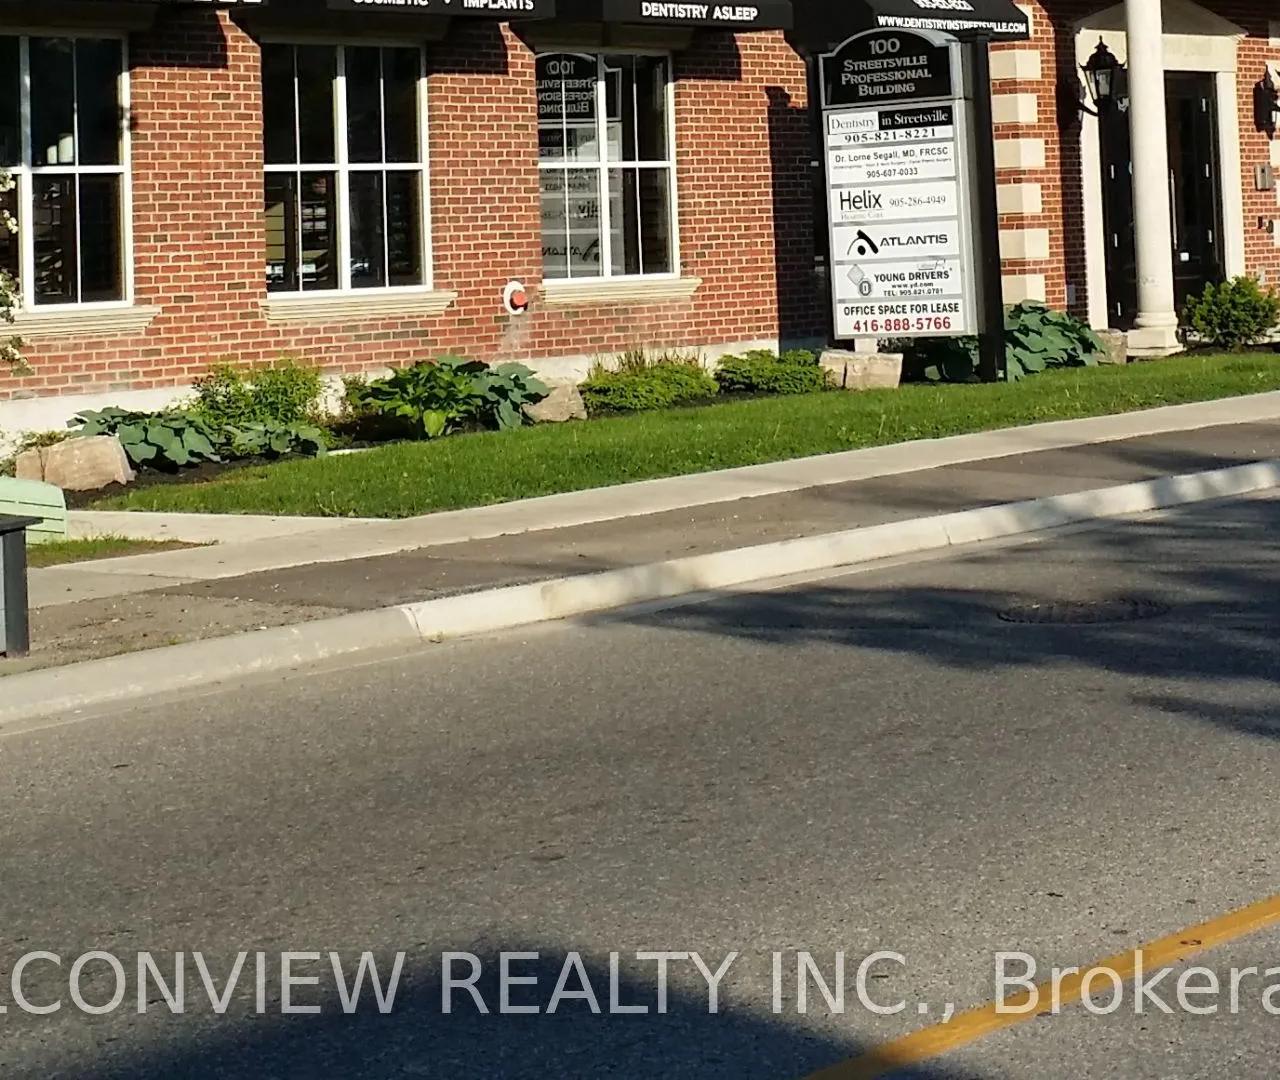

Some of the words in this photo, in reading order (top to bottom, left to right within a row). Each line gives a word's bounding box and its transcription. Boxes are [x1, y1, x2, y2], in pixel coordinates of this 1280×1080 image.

[641, 2, 708, 19] DENTISTRY
[713, 6, 758, 20] ASLEEP
[869, 38, 900, 55] 100
[844, 55, 928, 72] STREETSVILLE
[841, 68, 932, 85] PROFESSIONAL
[858, 83, 915, 97] BUILDING
[831, 118, 874, 130] Dentistry
[882, 114, 892, 125] in
[894, 110, 948, 125] Streetsville
[845, 128, 936, 143] 905-821-8221
[835, 155, 847, 163] Dr.
[874, 151, 900, 161] Segall,
[920, 147, 949, 156] FRCSC
[840, 190, 882, 210] Helix
[880, 234, 948, 247] ATLANTIS
[874, 273, 905, 282] YOUNG
[909, 270, 949, 280] DRIVERS
[844, 306, 875, 316] OFFICE
[878, 305, 907, 314] SPACE
[910, 304, 928, 313] FOR
[931, 302, 960, 313] LEASE
